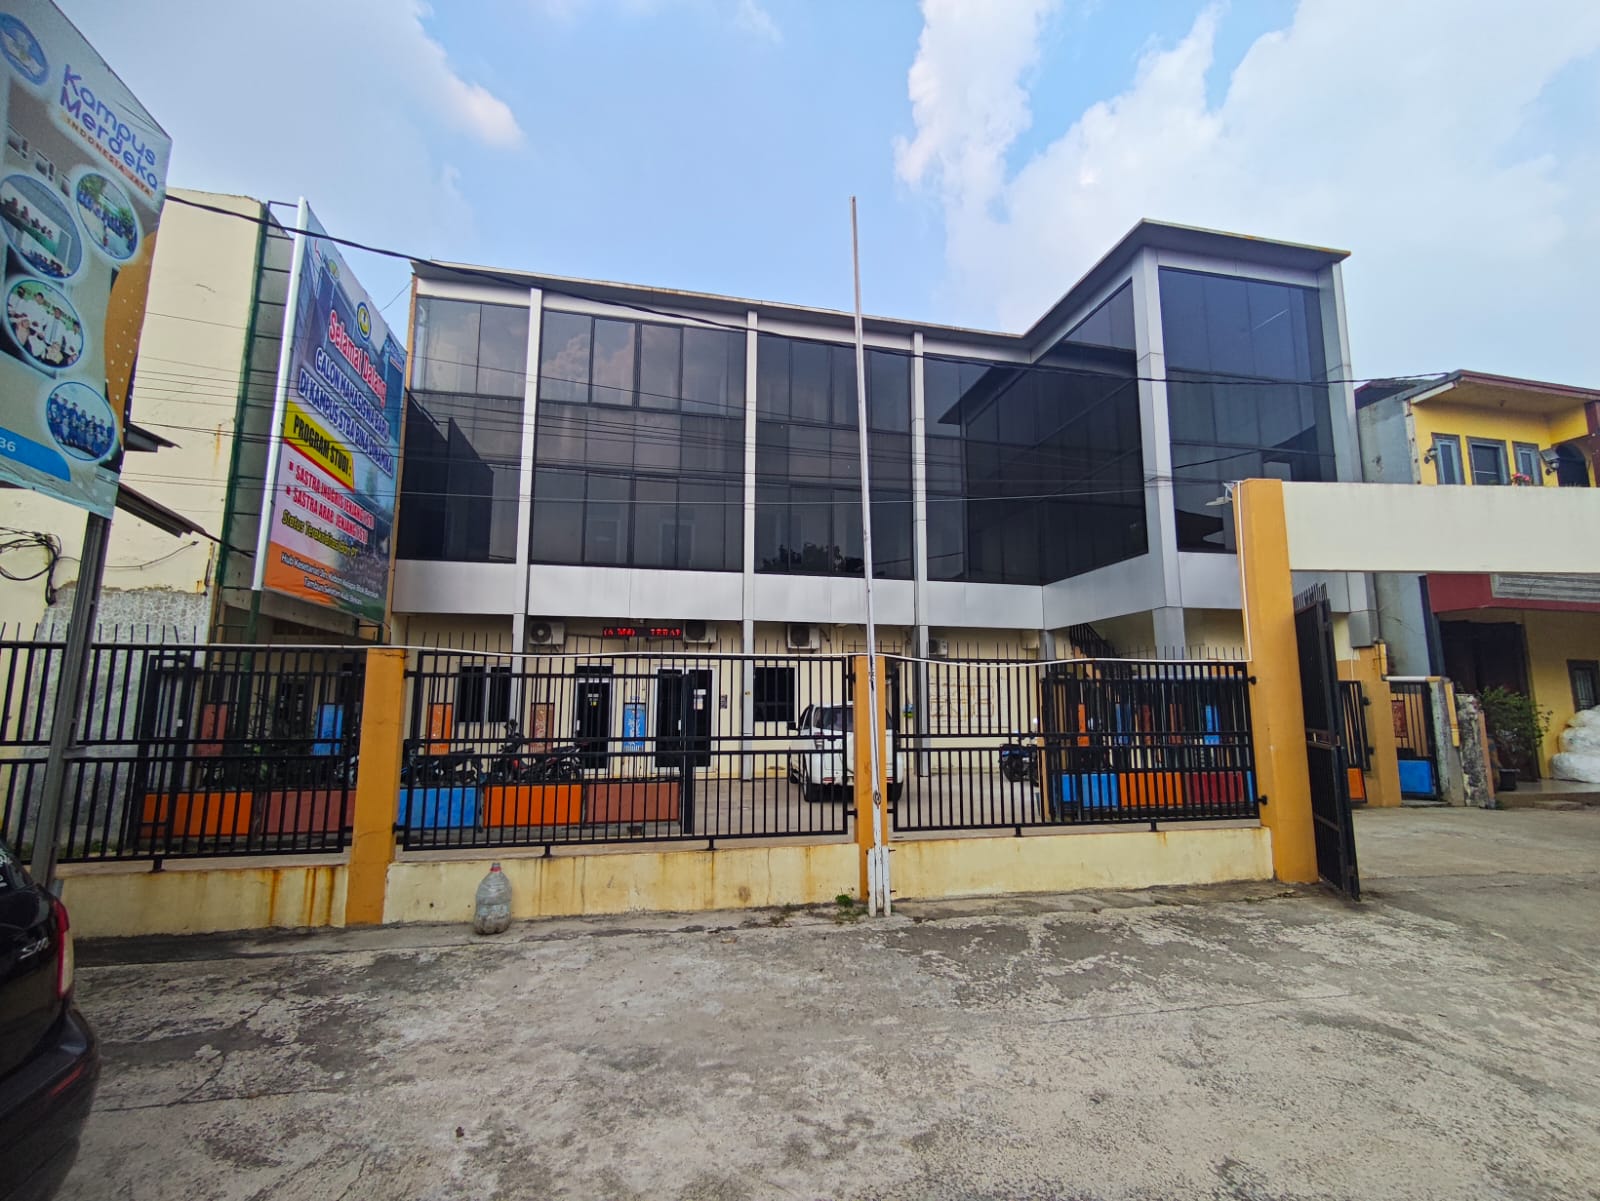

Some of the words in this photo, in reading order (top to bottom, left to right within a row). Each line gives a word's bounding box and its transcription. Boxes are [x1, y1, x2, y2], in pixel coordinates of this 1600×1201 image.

[60, 86, 158, 191] Merdeka
[64, 63, 156, 166] Kampus
[67, 117, 126, 174] INDONESIA
[329, 310, 361, 374] Selamat
[362, 352, 387, 408] Datang
[309, 376, 339, 425] KAMPUS
[293, 414, 330, 460] PROGRAM
[329, 445, 349, 474] STUDI
[293, 488, 318, 515] SASTRA
[296, 465, 321, 492] SASTRA
[281, 508, 305, 533] Status
